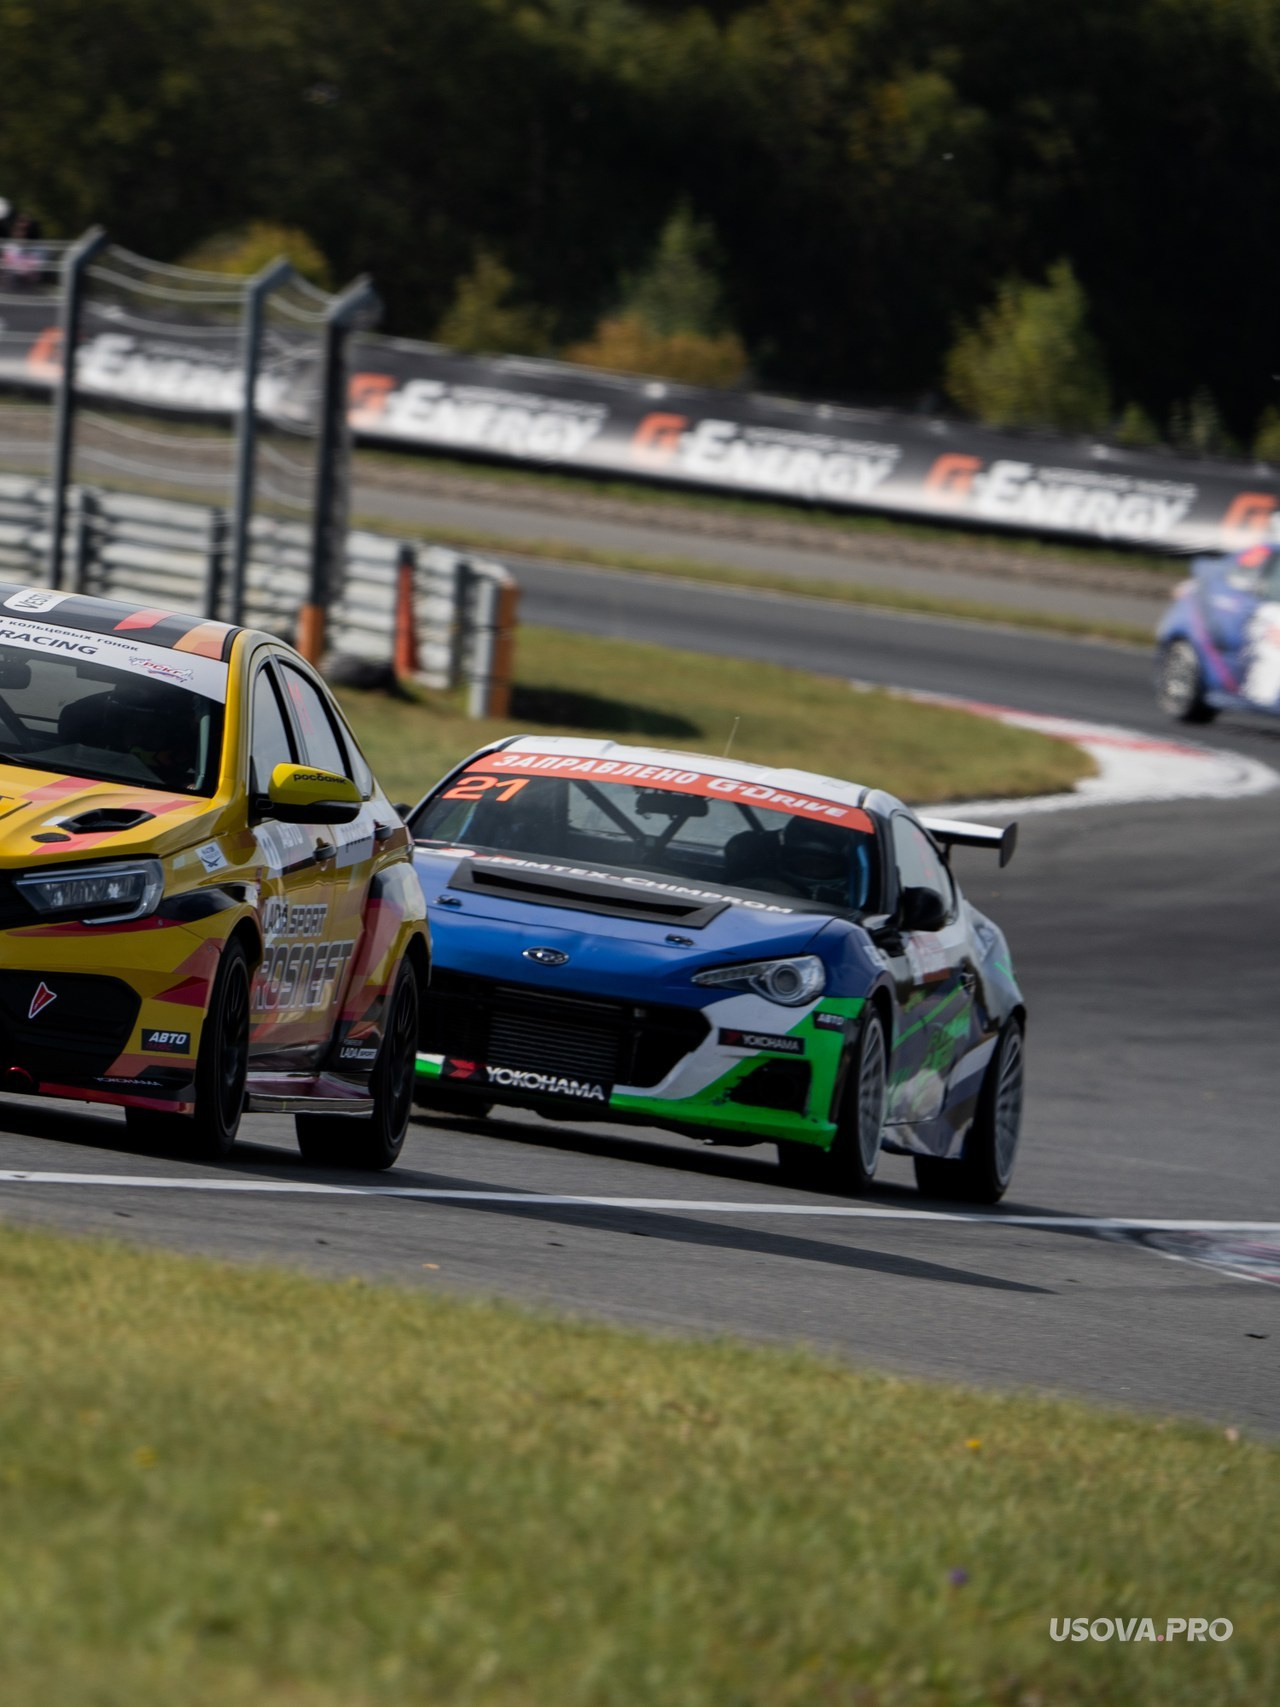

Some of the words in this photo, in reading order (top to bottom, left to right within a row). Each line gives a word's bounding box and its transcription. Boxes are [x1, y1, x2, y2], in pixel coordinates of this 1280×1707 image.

[9, 621, 92, 640] кольцевых
[97, 638, 139, 651] гонок
[492, 754, 701, 785] ЗАПРАВЛЕНО
[442, 775, 531, 802] 21
[288, 903, 328, 937] SPORT
[148, 1032, 187, 1045] АВТО
[742, 1034, 800, 1051] YOKOHAMA
[485, 1066, 605, 1101] YOKOHAMA
